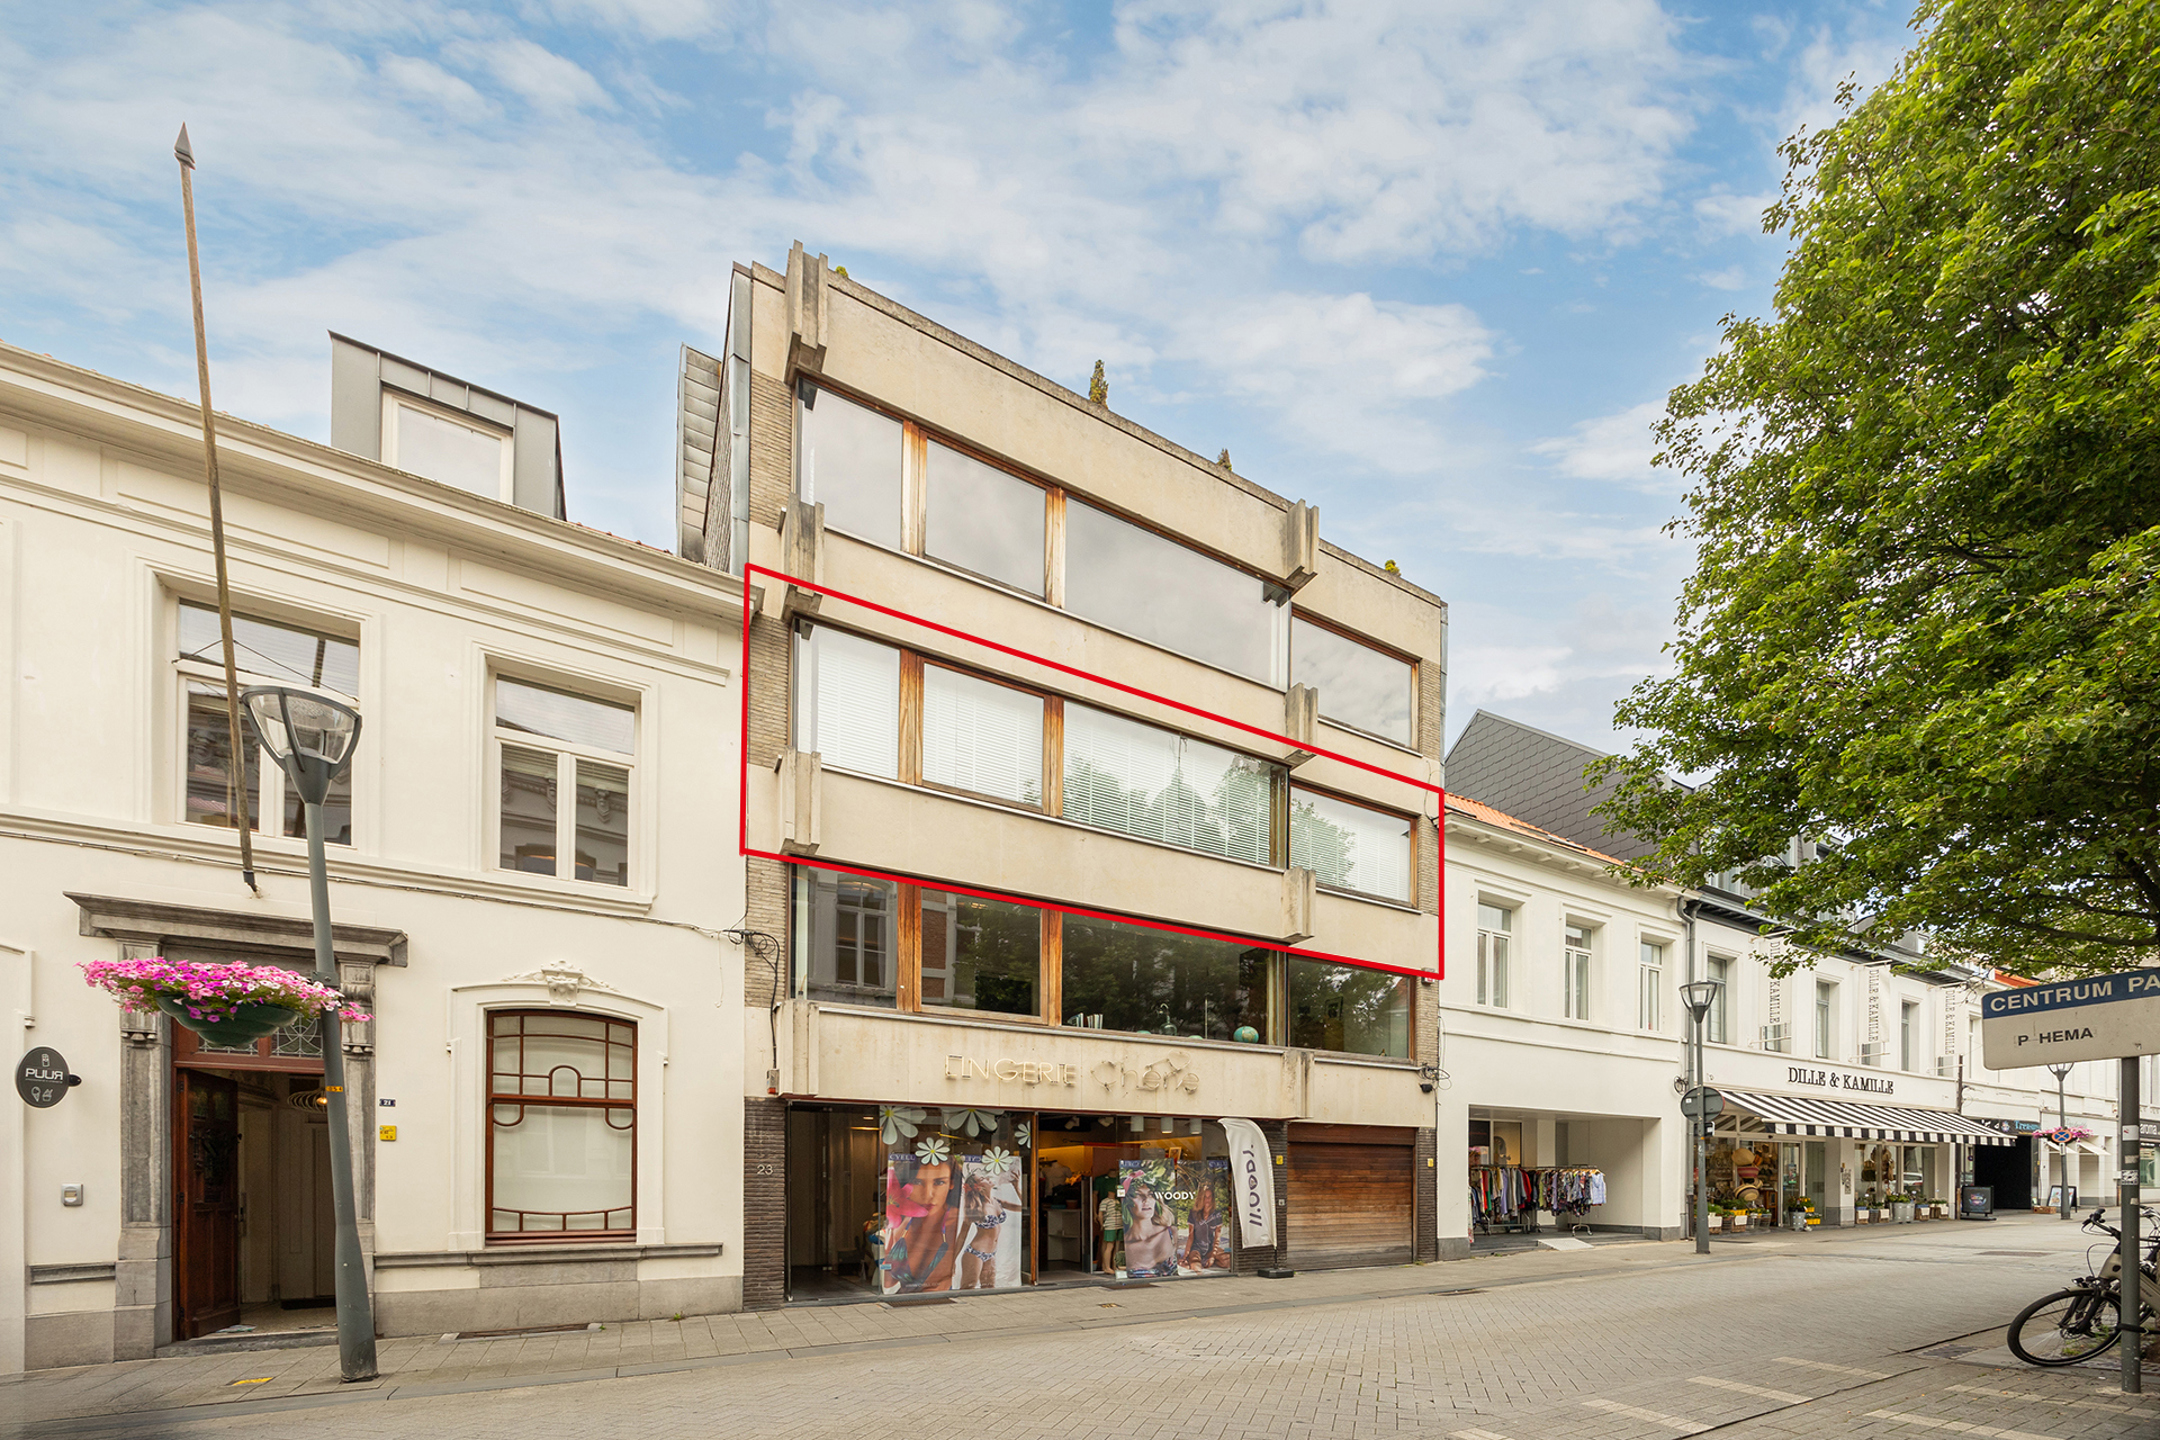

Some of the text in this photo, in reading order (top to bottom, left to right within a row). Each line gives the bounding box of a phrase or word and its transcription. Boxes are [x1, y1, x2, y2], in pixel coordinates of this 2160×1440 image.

[1868, 969, 1880, 994] DILLE
[1769, 980, 1781, 1024] KAMILLE
[1944, 990, 1956, 1012] DILLE
[1990, 981, 2113, 1012] CENTRUM
[1868, 1003, 1880, 1042] KAMILLE
[1944, 1021, 1956, 1055] KAMILLE
[2018, 1027, 2094, 1046] P HEMA
[25, 1068, 64, 1080] PUUR
[945, 1054, 1079, 1088] LINGERIE
[1787, 1067, 1895, 1095] DILLE & KAMILLE
[757, 1164, 774, 1176] 23
[1154, 1191, 1197, 1201] WOODY
